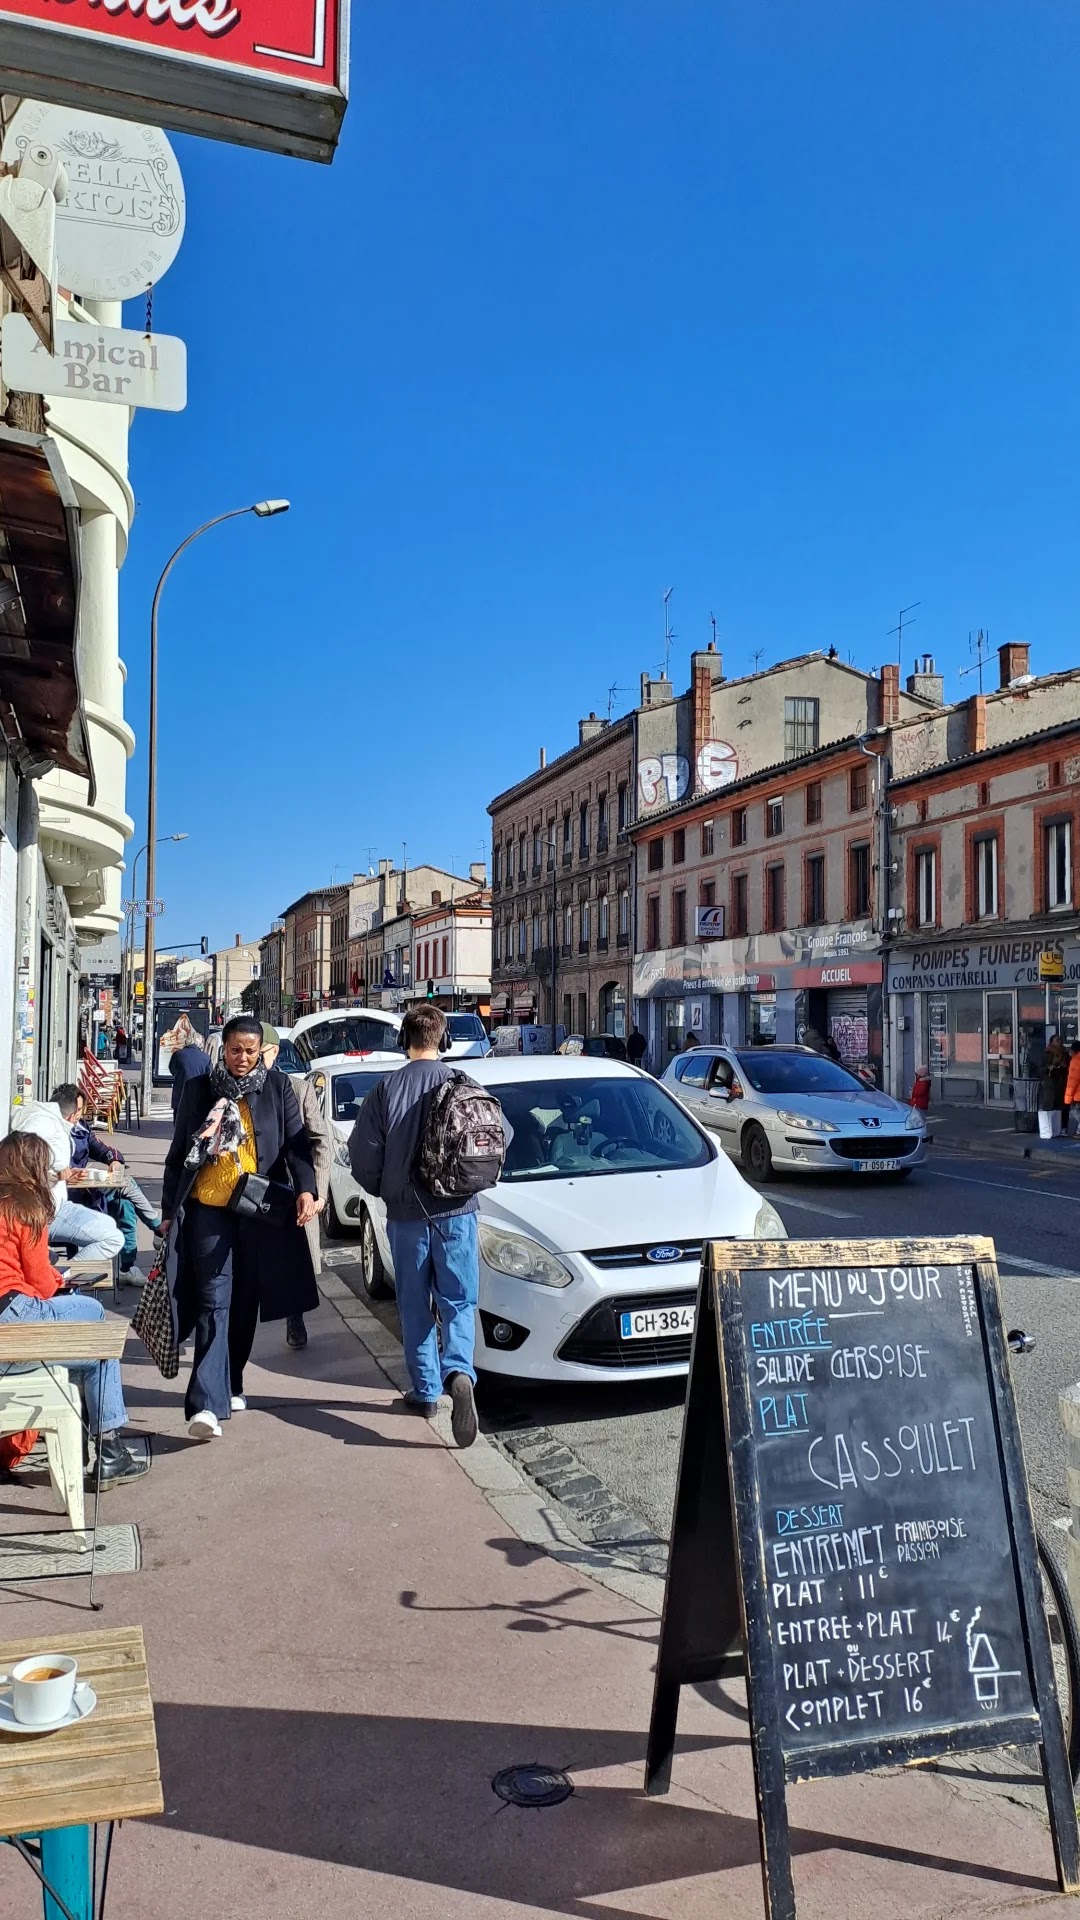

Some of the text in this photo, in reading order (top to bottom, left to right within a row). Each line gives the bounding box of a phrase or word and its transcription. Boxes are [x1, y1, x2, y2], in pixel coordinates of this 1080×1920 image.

[61, 160, 152, 193] ELLA
[57, 189, 154, 220] RTOIS
[63, 362, 132, 395] Bar
[808, 928, 867, 949] Groupe François
[912, 947, 970, 971] POMPES
[683, 979, 697, 989] Pneus
[821, 968, 851, 983] ACCUEIL
[892, 972, 936, 990] COMPANS
[938, 970, 998, 987] CAFFARELLI
[655, 1248, 676, 1259] Ford
[769, 1266, 942, 1309] MENU DU JOUR
[959, 1288, 973, 1338] EMPORTER
[967, 1289, 978, 1318] PLACE
[634, 1310, 694, 1333] CH-384-
[751, 1310, 833, 1348] ENTRÉE
[756, 1343, 930, 1386] SALADE GERSOISE
[759, 1393, 809, 1430] PLAT
[808, 1416, 977, 1490] CASSOULET
[776, 1503, 844, 1534] DESSERT
[772, 1517, 968, 1578] ENTREMET FRAMBOISE
[897, 1542, 941, 1562] PASSION
[772, 1579, 826, 1608] PLAT
[777, 1615, 853, 1645] ENTREE
[866, 1608, 917, 1638] PLAT
[847, 1644, 859, 1656] OU
[783, 1658, 831, 1691] PLAT
[848, 1650, 935, 1683] DESSERT
[785, 1690, 884, 1731] COMPLET
